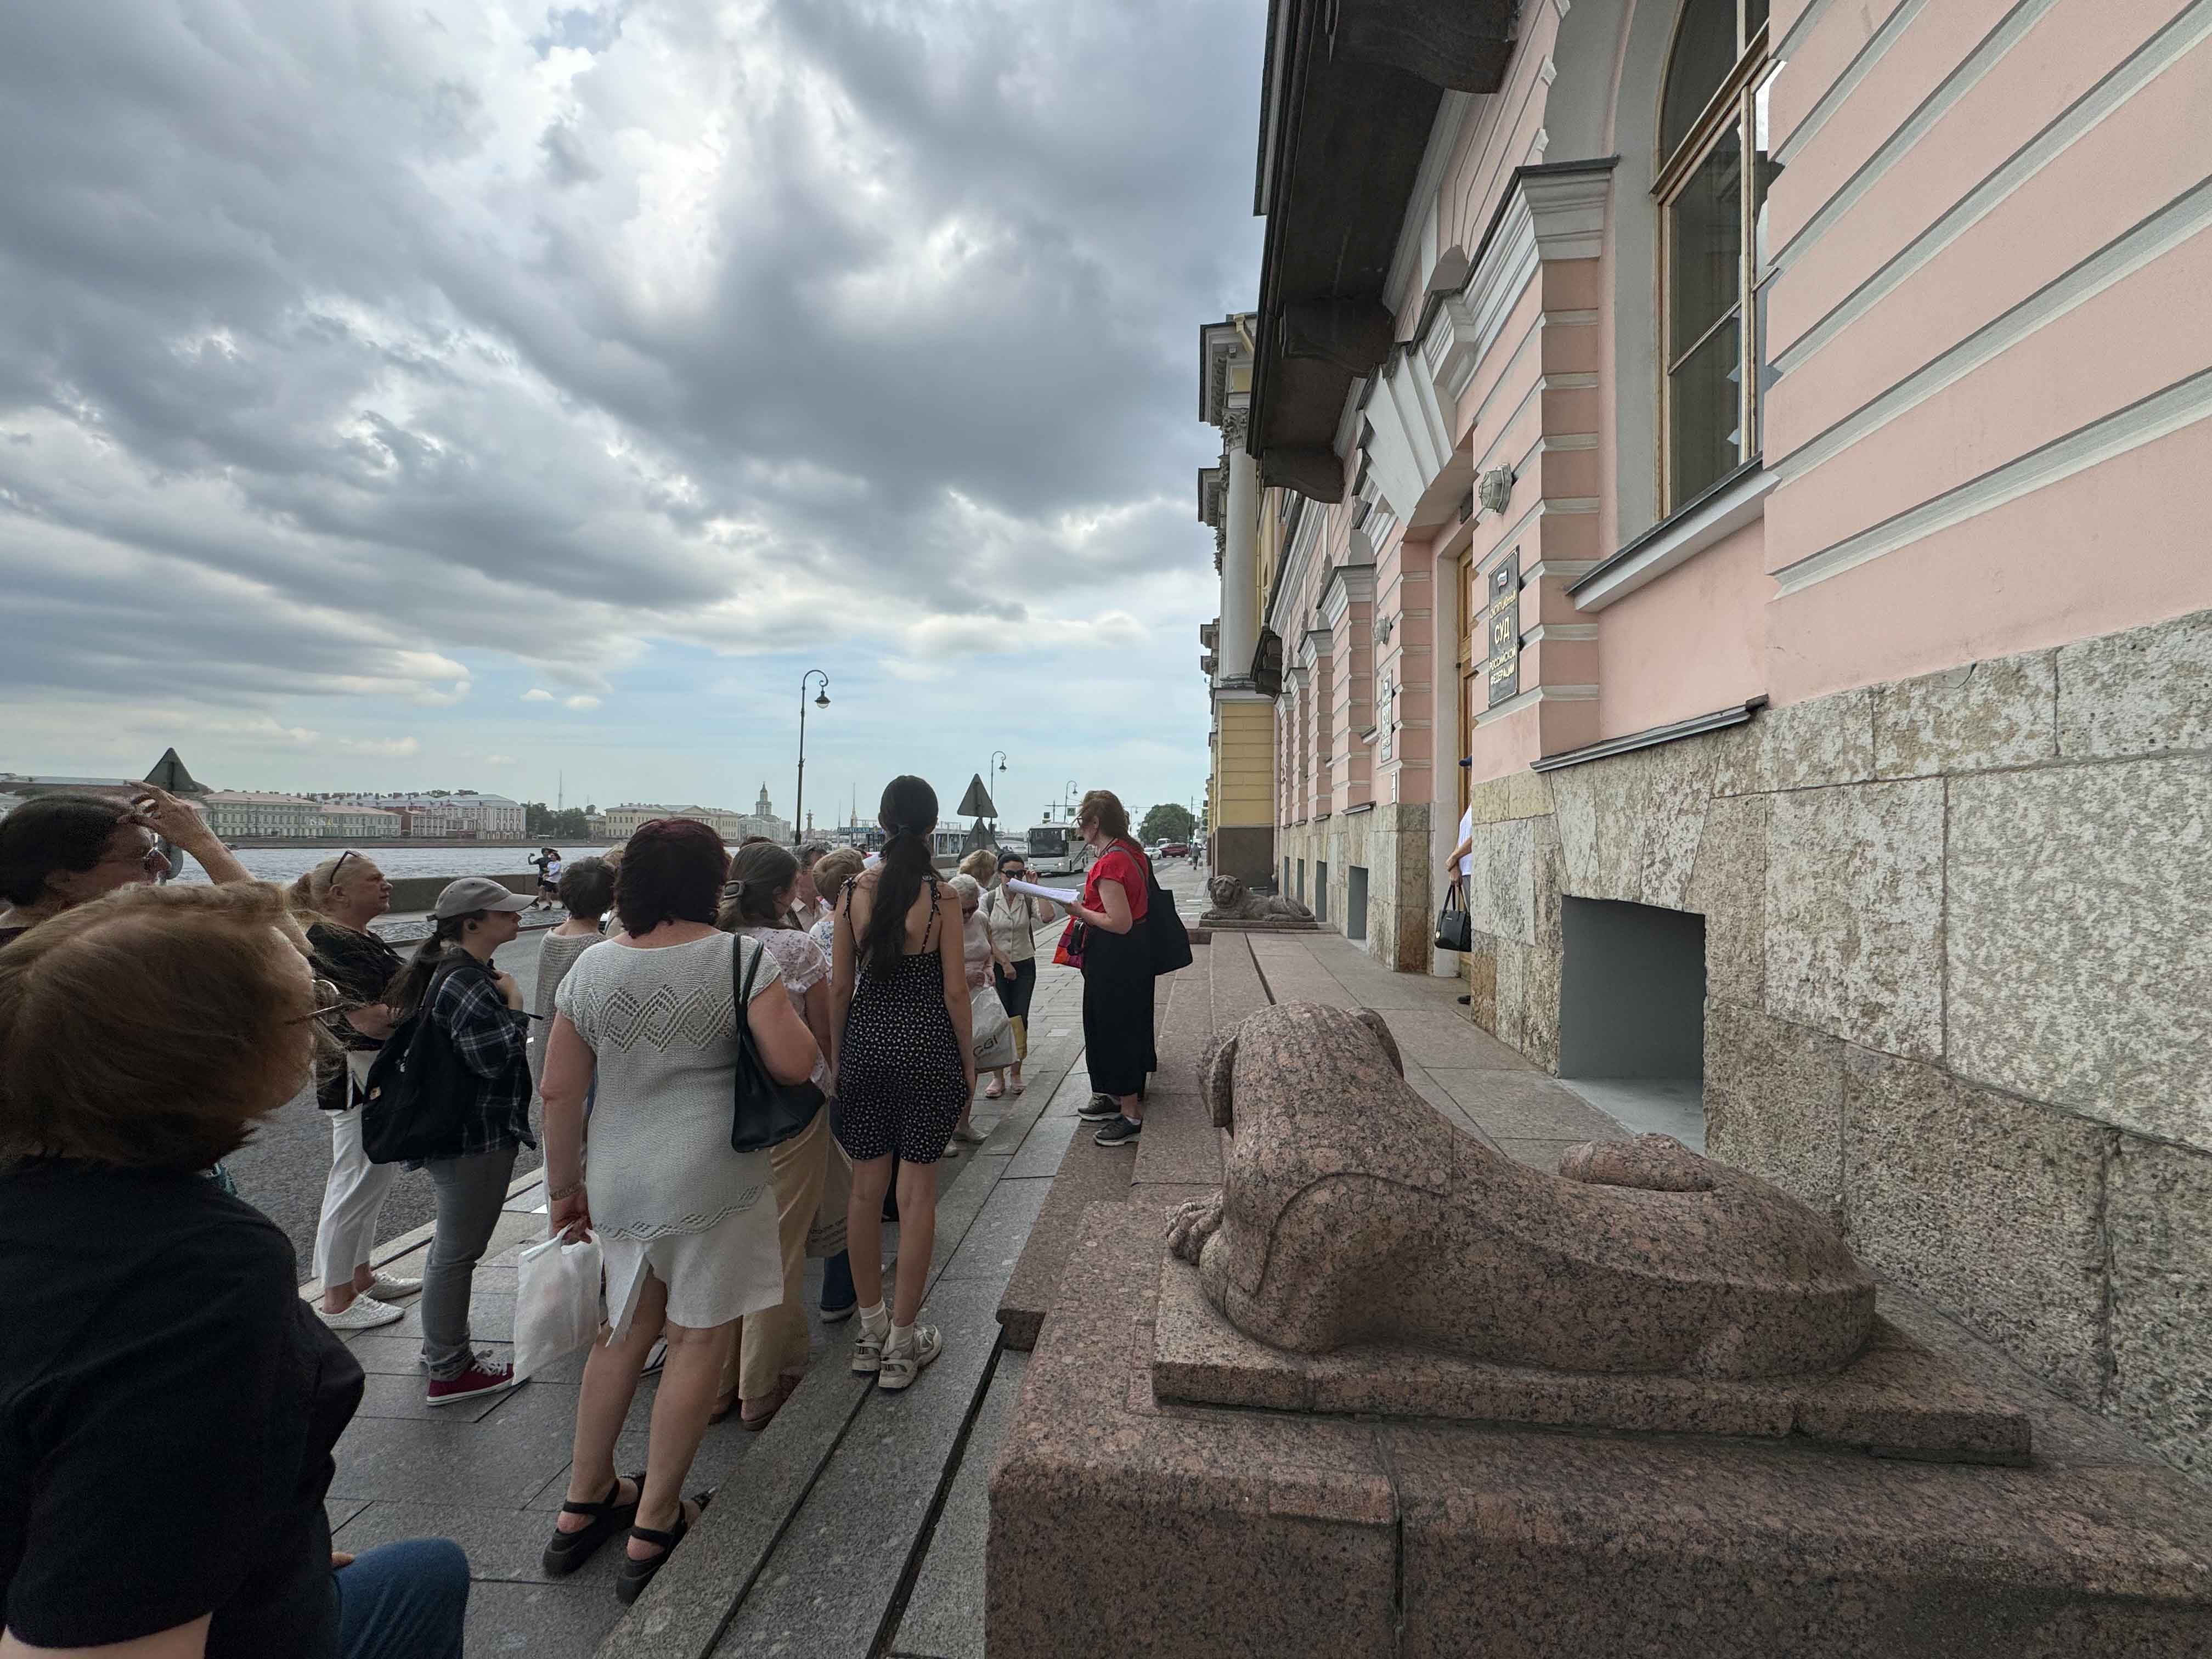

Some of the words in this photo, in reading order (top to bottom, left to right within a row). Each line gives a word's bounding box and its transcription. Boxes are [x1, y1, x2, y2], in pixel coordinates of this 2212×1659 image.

[1494, 616, 1510, 645] СУД
[1489, 644, 1516, 672] РОССИЙСКОЙ
[1491, 662, 1515, 685] ФЕДЕРАЦИИ
